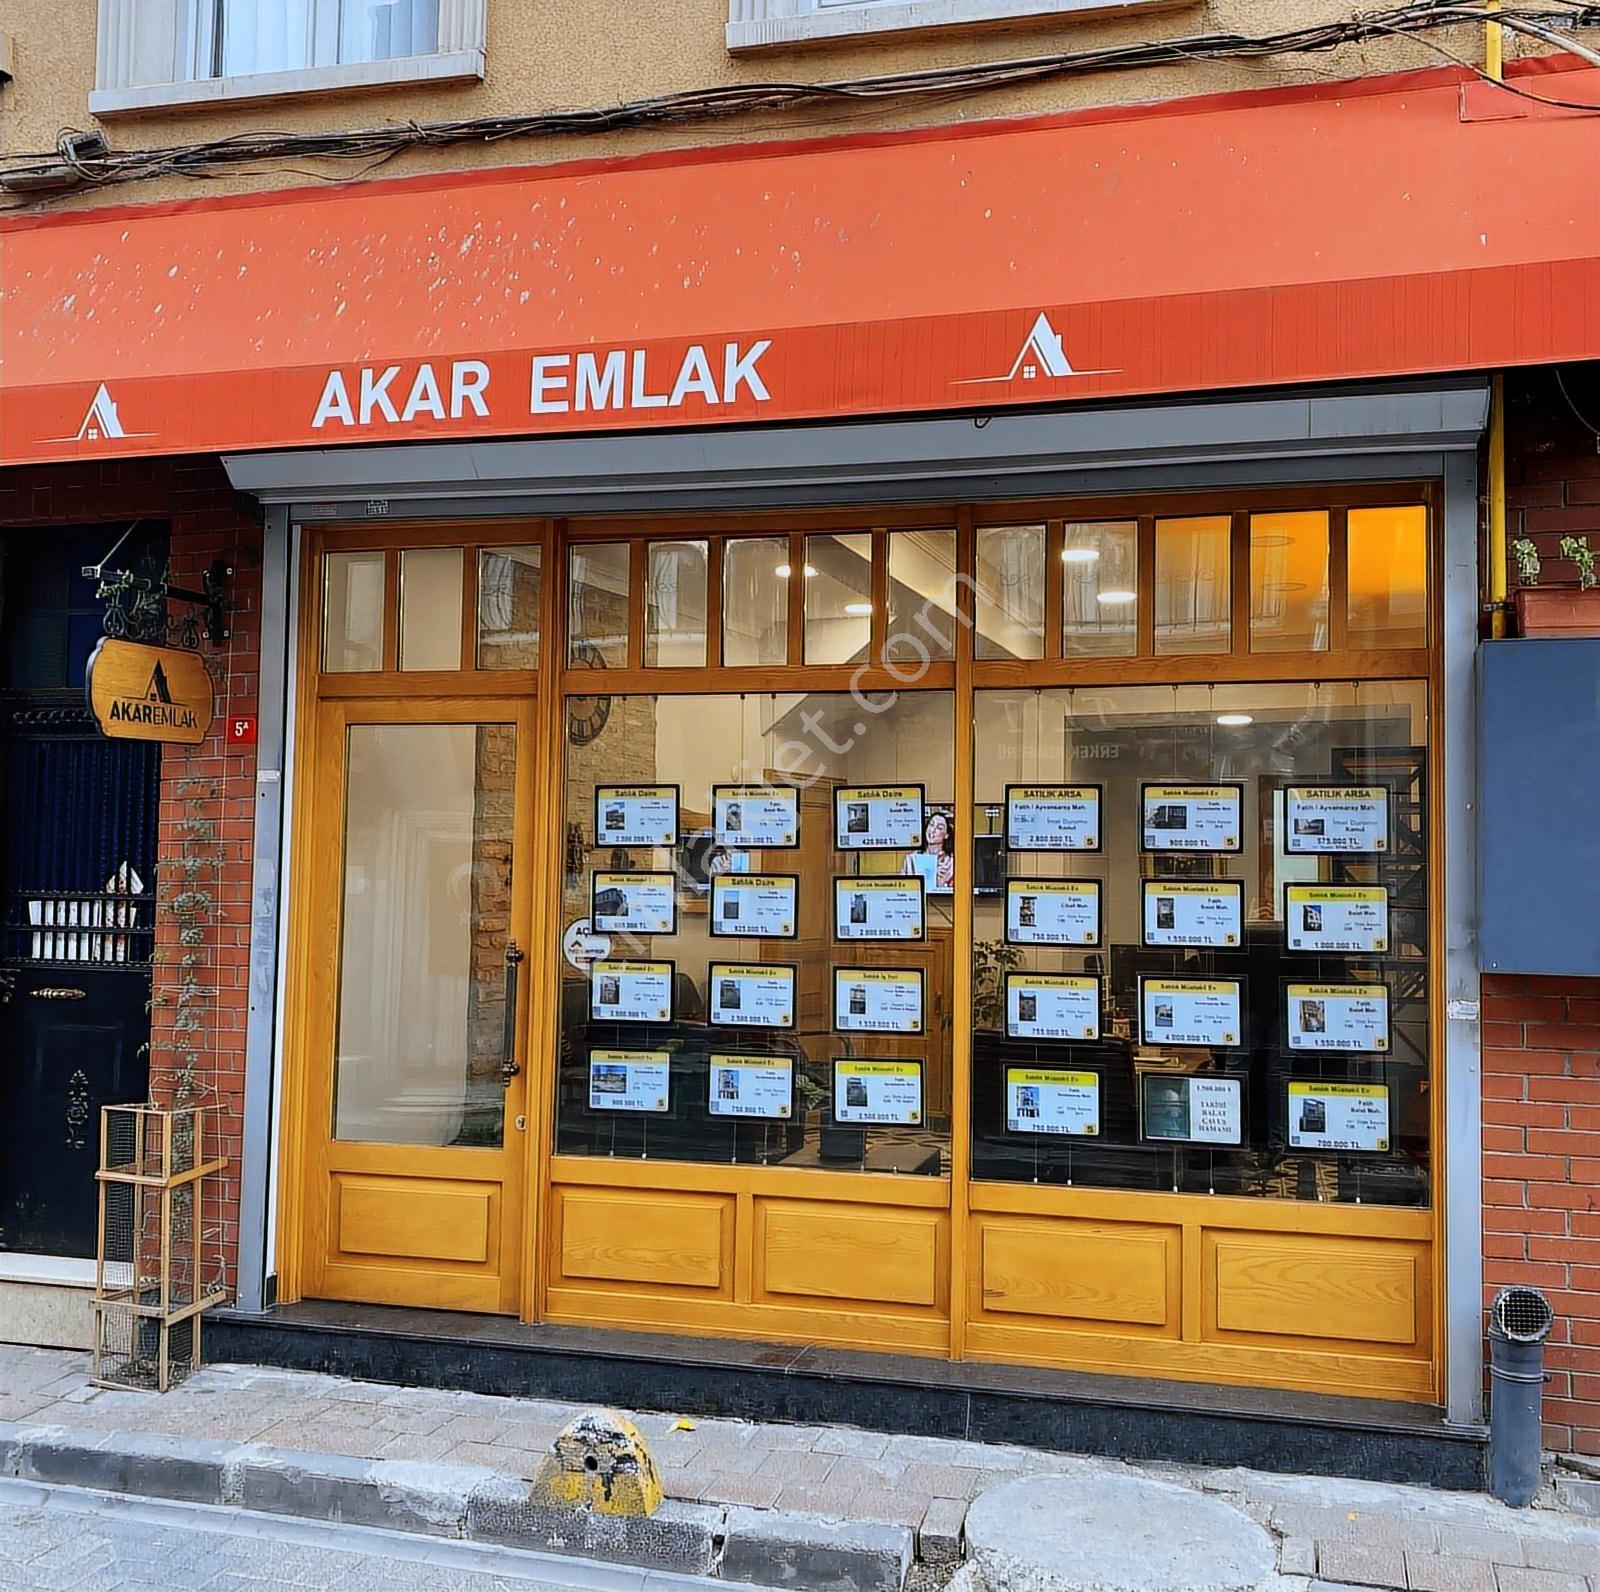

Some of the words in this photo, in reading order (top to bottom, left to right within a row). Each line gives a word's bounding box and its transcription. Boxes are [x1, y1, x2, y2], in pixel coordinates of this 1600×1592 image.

[311, 359, 490, 428] AKAR
[530, 339, 773, 414] EMLAK
[1344, 790, 1372, 798] ARSA
